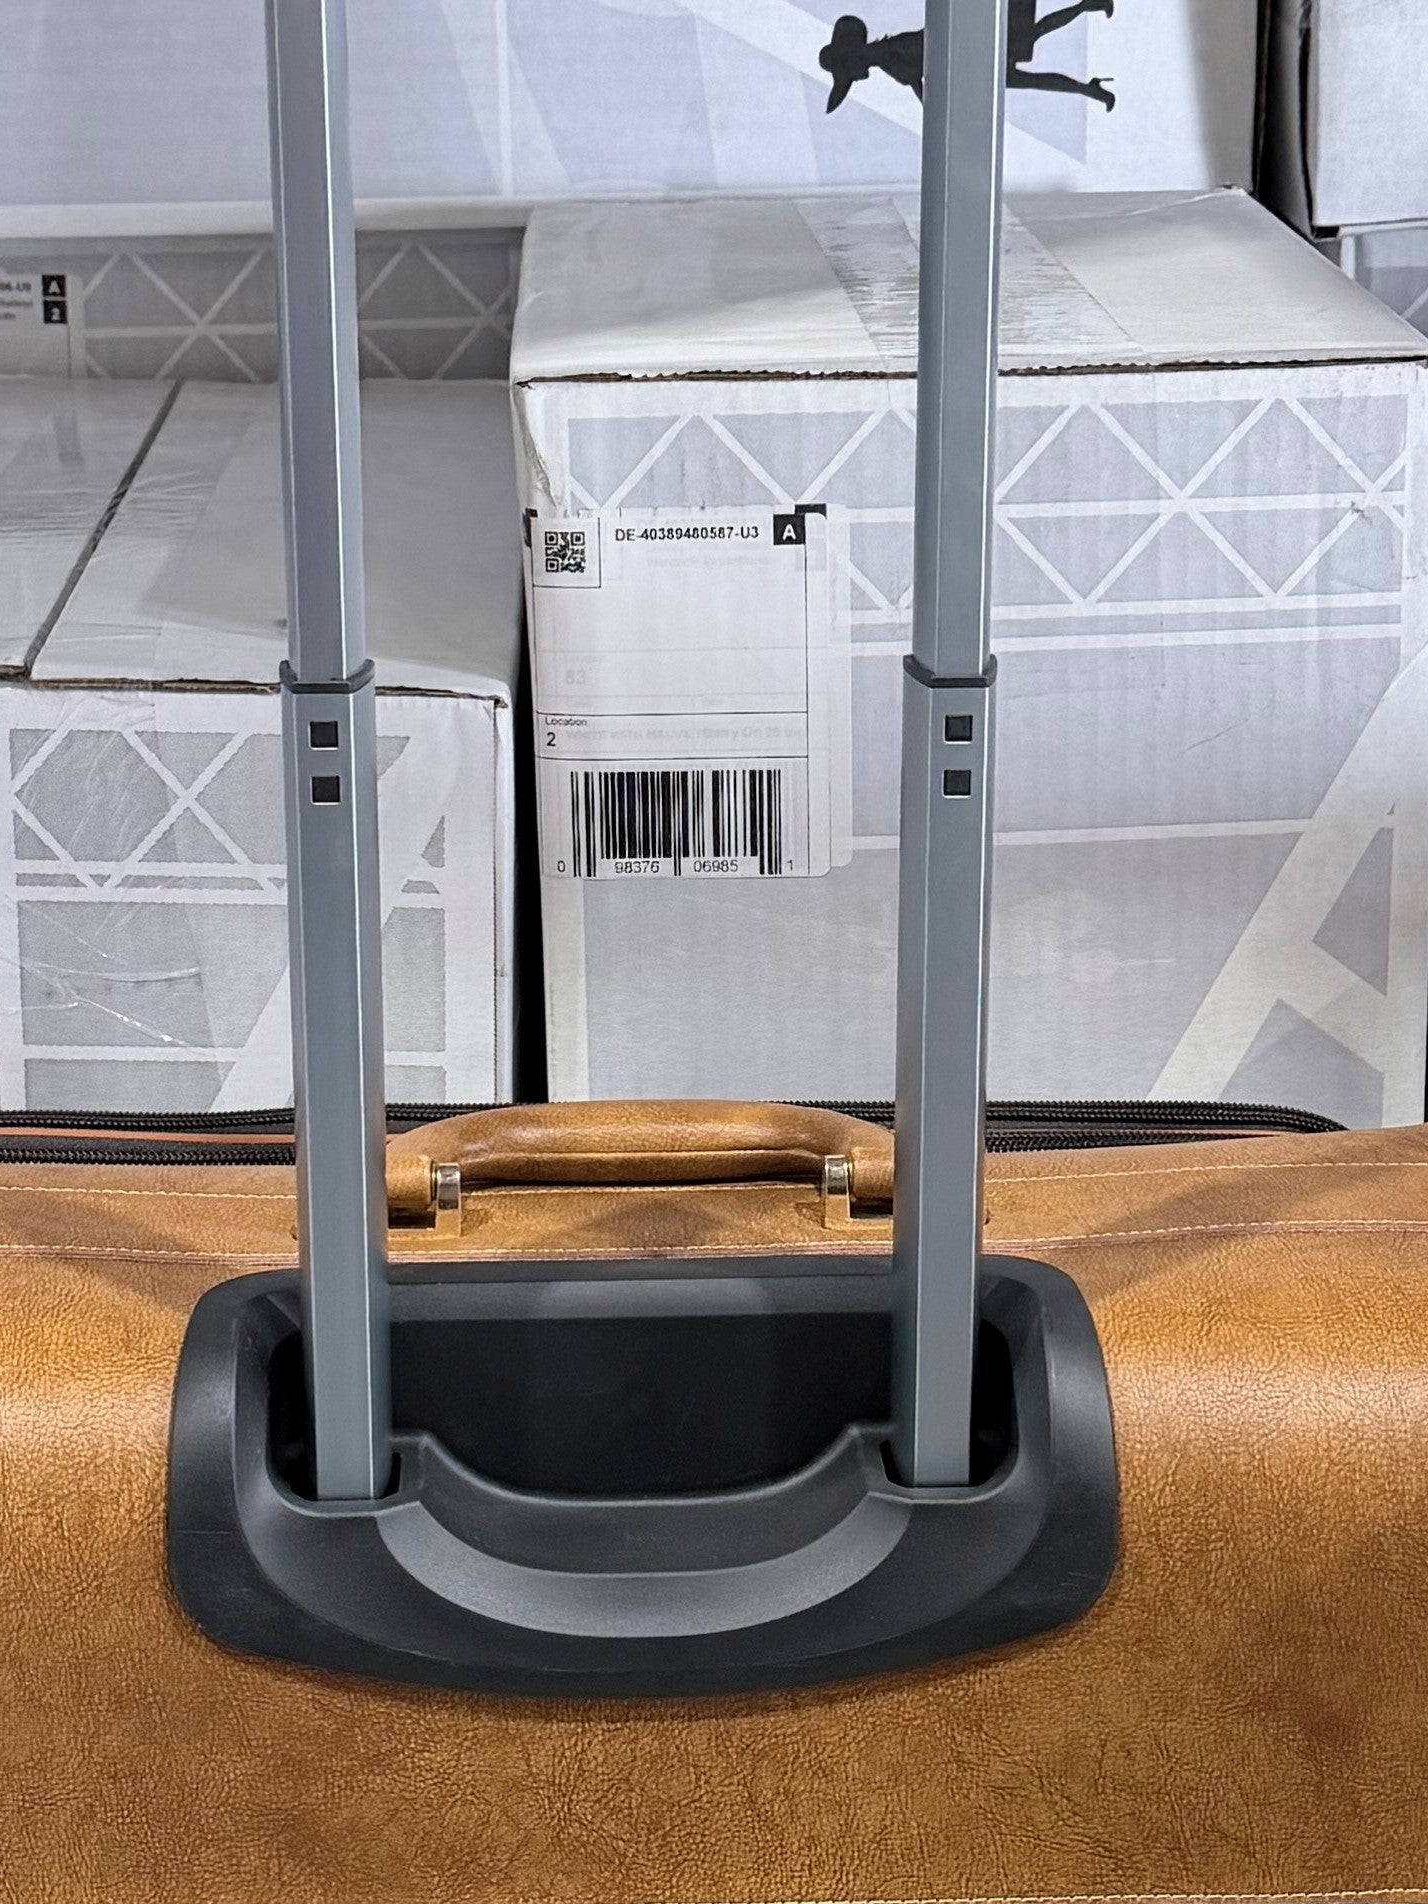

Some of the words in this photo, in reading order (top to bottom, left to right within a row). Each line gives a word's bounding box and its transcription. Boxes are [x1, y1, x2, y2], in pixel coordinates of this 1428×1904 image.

[782, 523, 798, 541] A
[544, 717, 588, 728] Location
[546, 732, 557, 747] 2
[557, 860, 566, 874] 0
[614, 860, 661, 874] 98376
[693, 859, 739, 874] 06985
